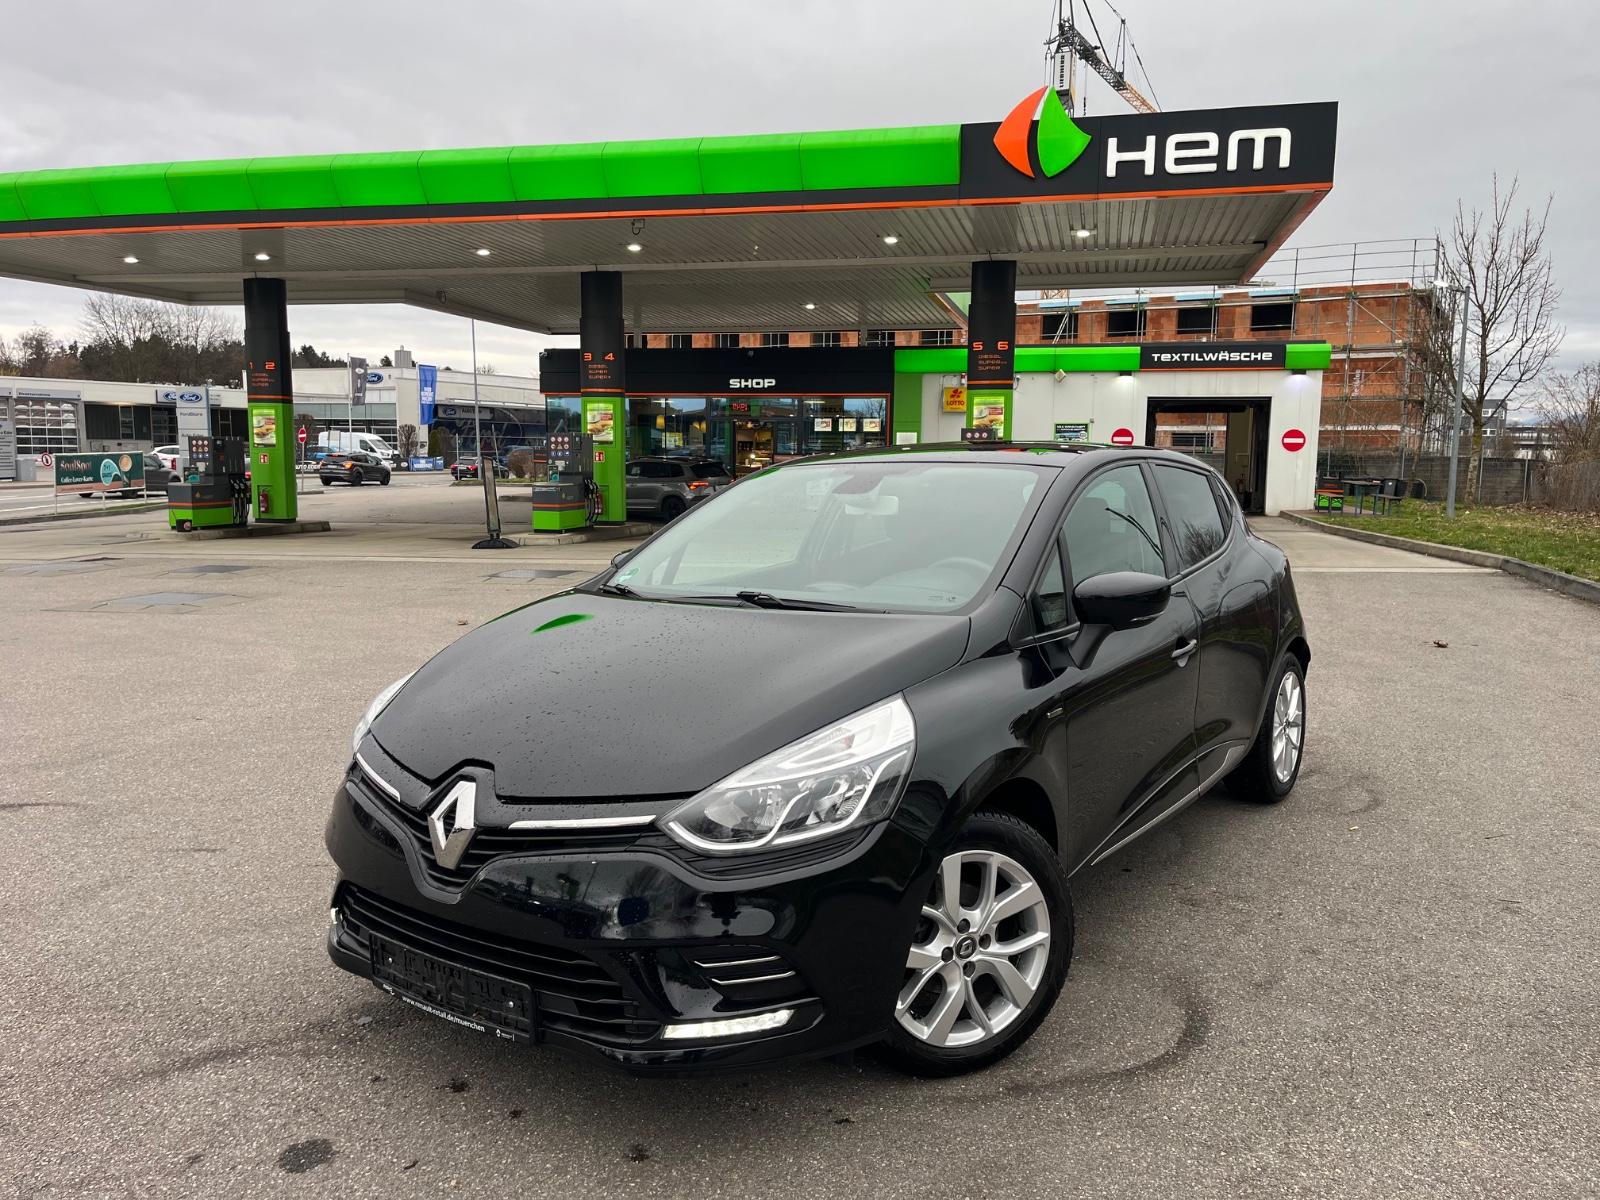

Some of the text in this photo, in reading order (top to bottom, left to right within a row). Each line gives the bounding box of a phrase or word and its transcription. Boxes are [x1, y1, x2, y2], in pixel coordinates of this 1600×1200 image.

[972, 341, 1009, 351] 5 6
[583, 352, 615, 361] 3 4
[264, 361, 276, 370] 2
[729, 378, 776, 389] SHOP
